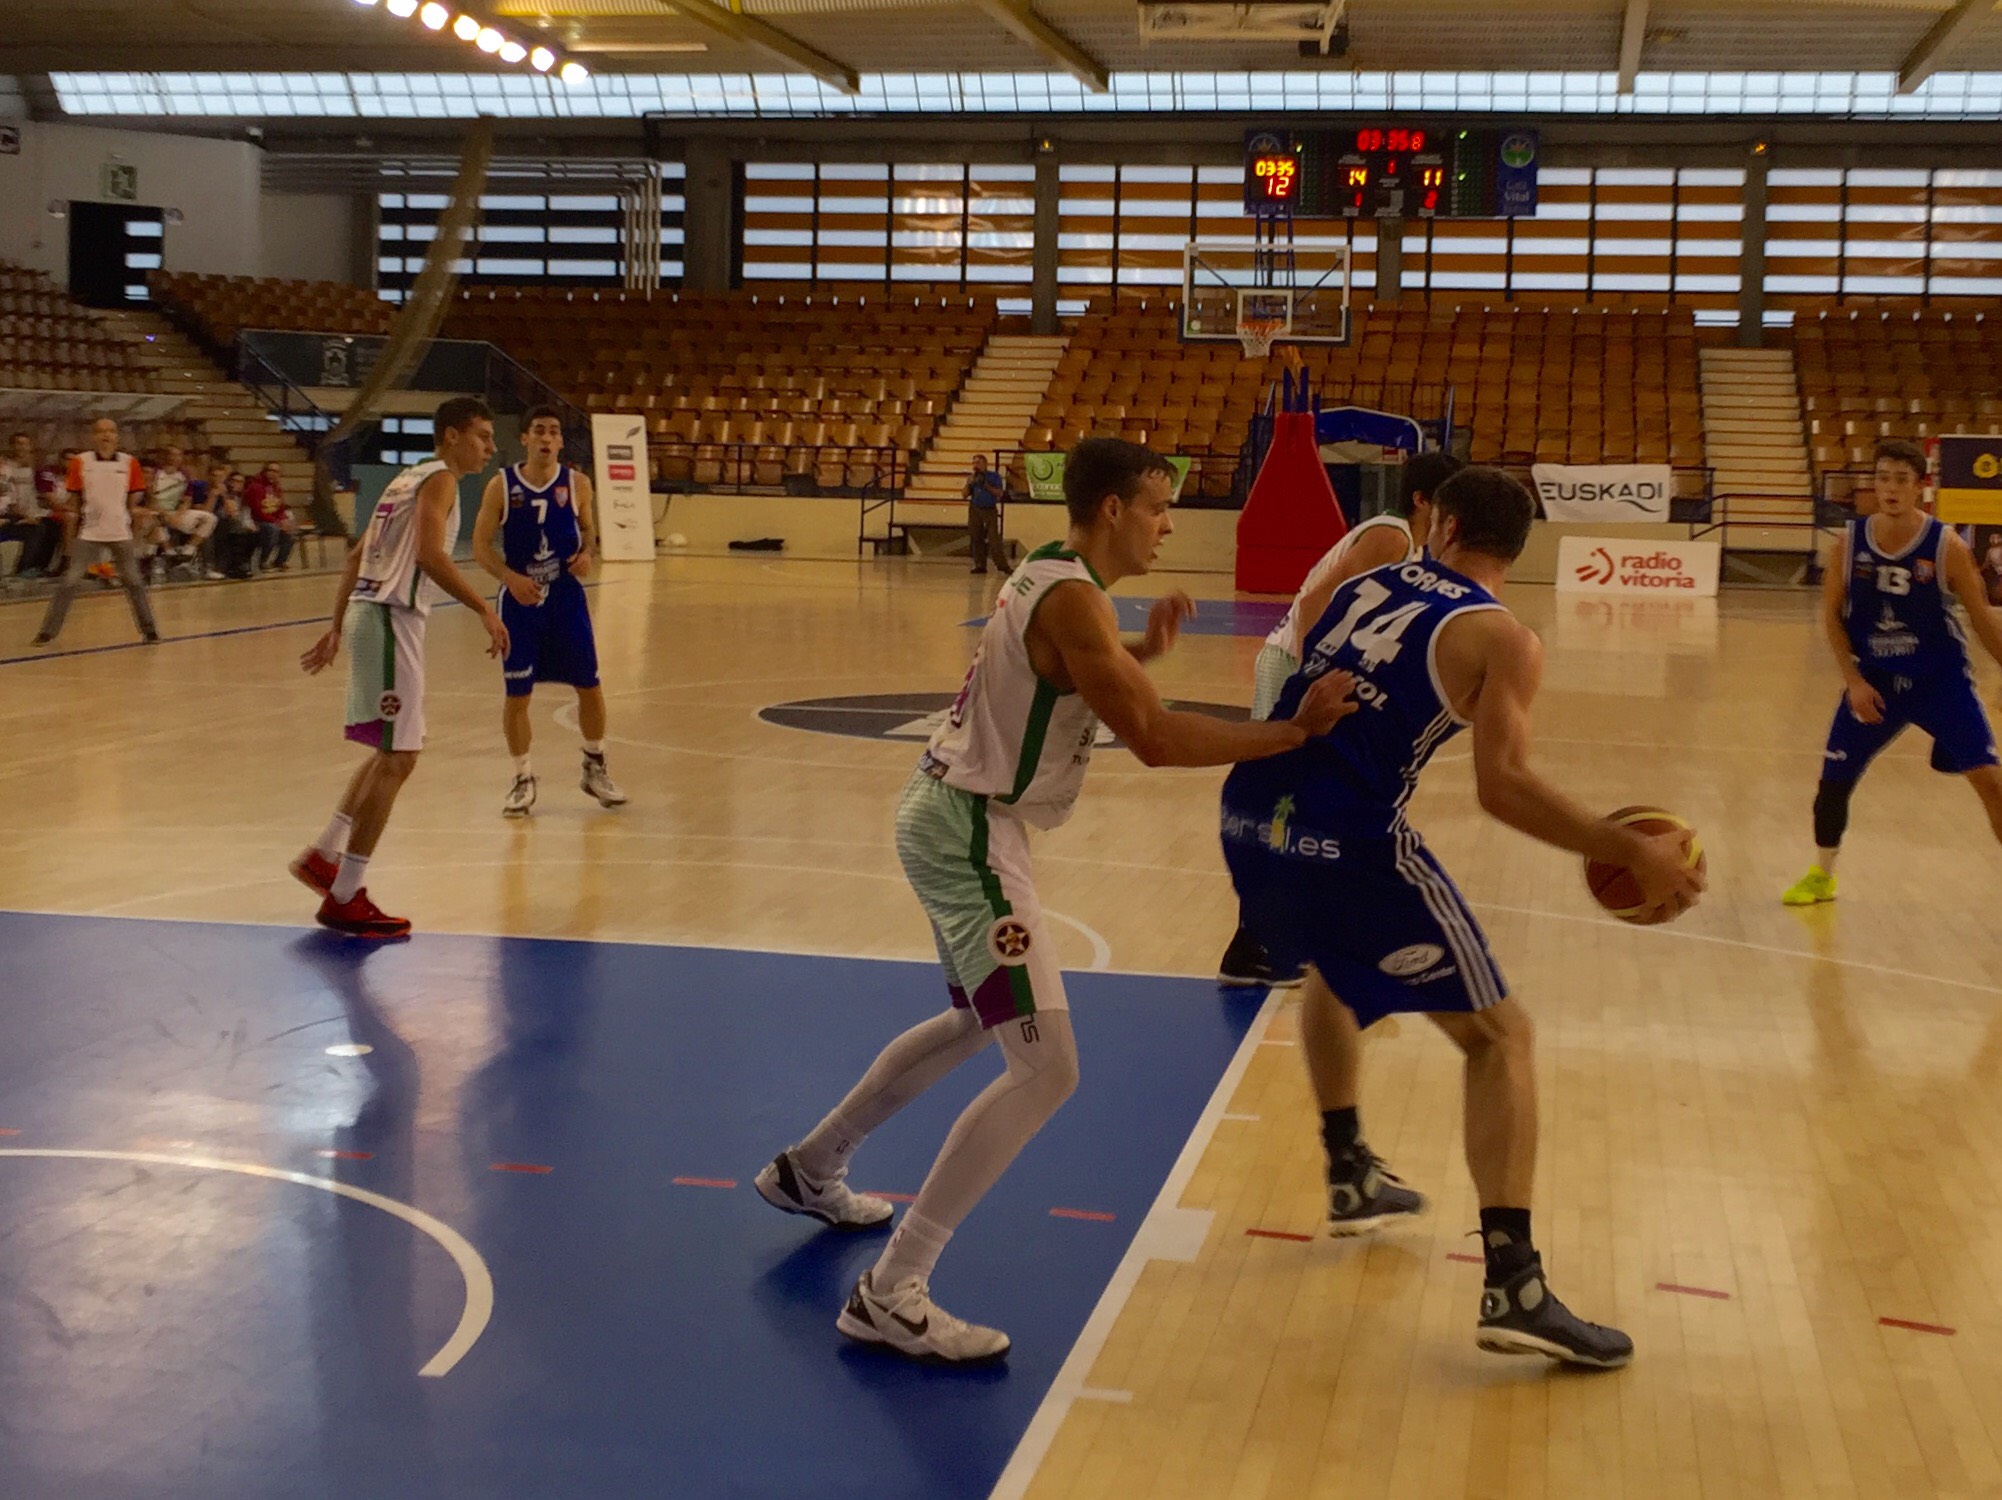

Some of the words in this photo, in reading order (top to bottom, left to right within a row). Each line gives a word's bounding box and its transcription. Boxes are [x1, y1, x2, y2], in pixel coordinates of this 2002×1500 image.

[1268, 176, 1289, 196] 12
[1349, 168, 1367, 186] 14
[1540, 482, 1663, 501] EUSKADI
[531, 499, 549, 524] 7
[1621, 551, 1682, 571] radio
[1620, 571, 1695, 588] vitoria
[1315, 577, 1433, 672] 14
